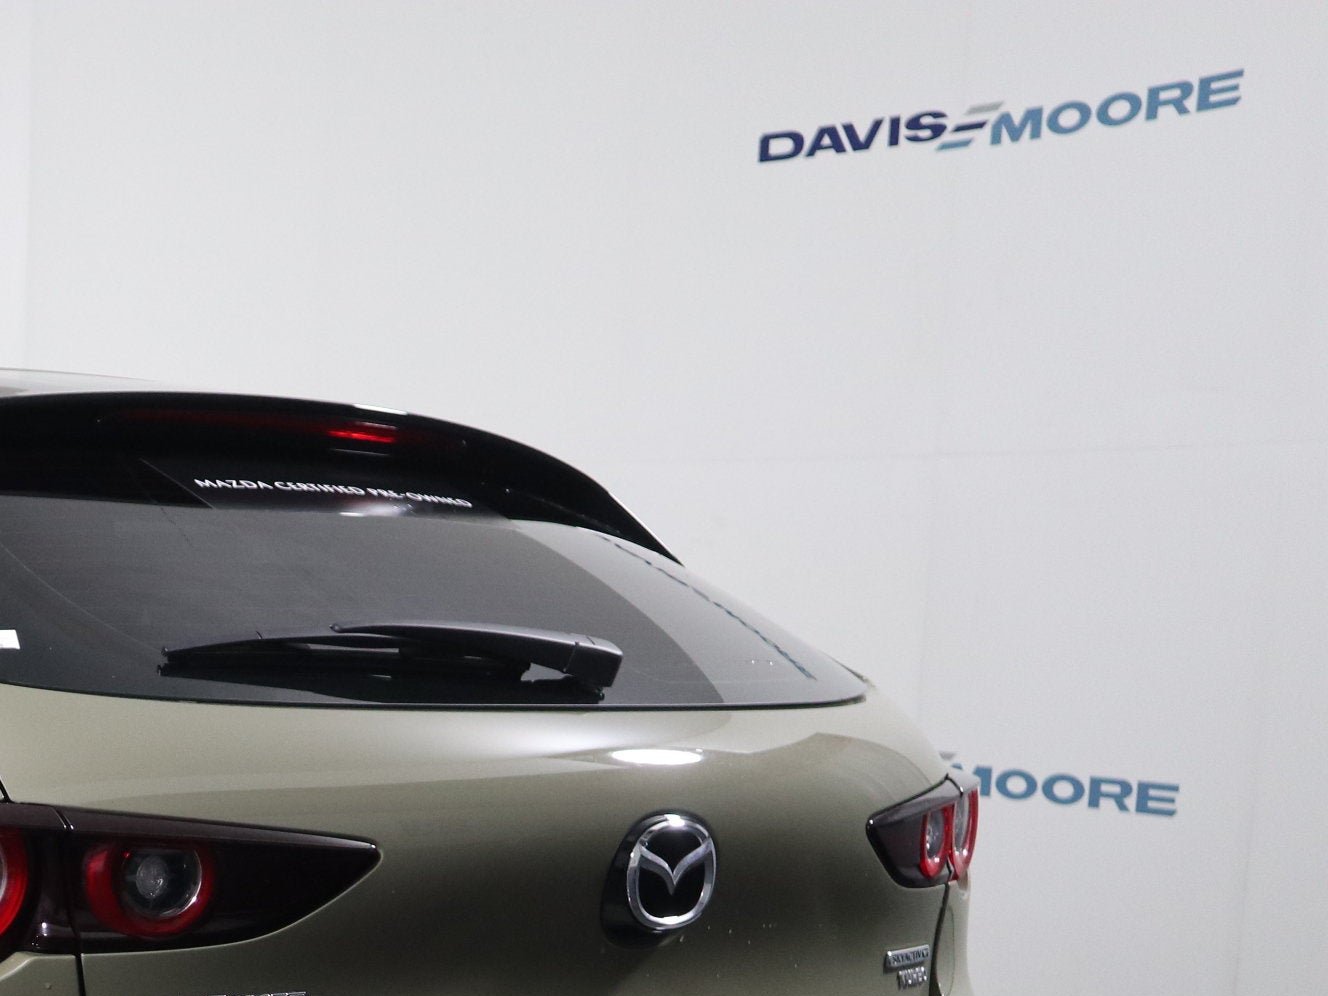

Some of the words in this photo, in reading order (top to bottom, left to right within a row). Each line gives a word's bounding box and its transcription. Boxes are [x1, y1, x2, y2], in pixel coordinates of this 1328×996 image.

[758, 111, 949, 163] DAVIS
[990, 68, 1244, 146] MOORE
[194, 478, 273, 489] MAZDA
[274, 481, 365, 496] CERTIFIED
[367, 487, 472, 508] PRE-OWNED
